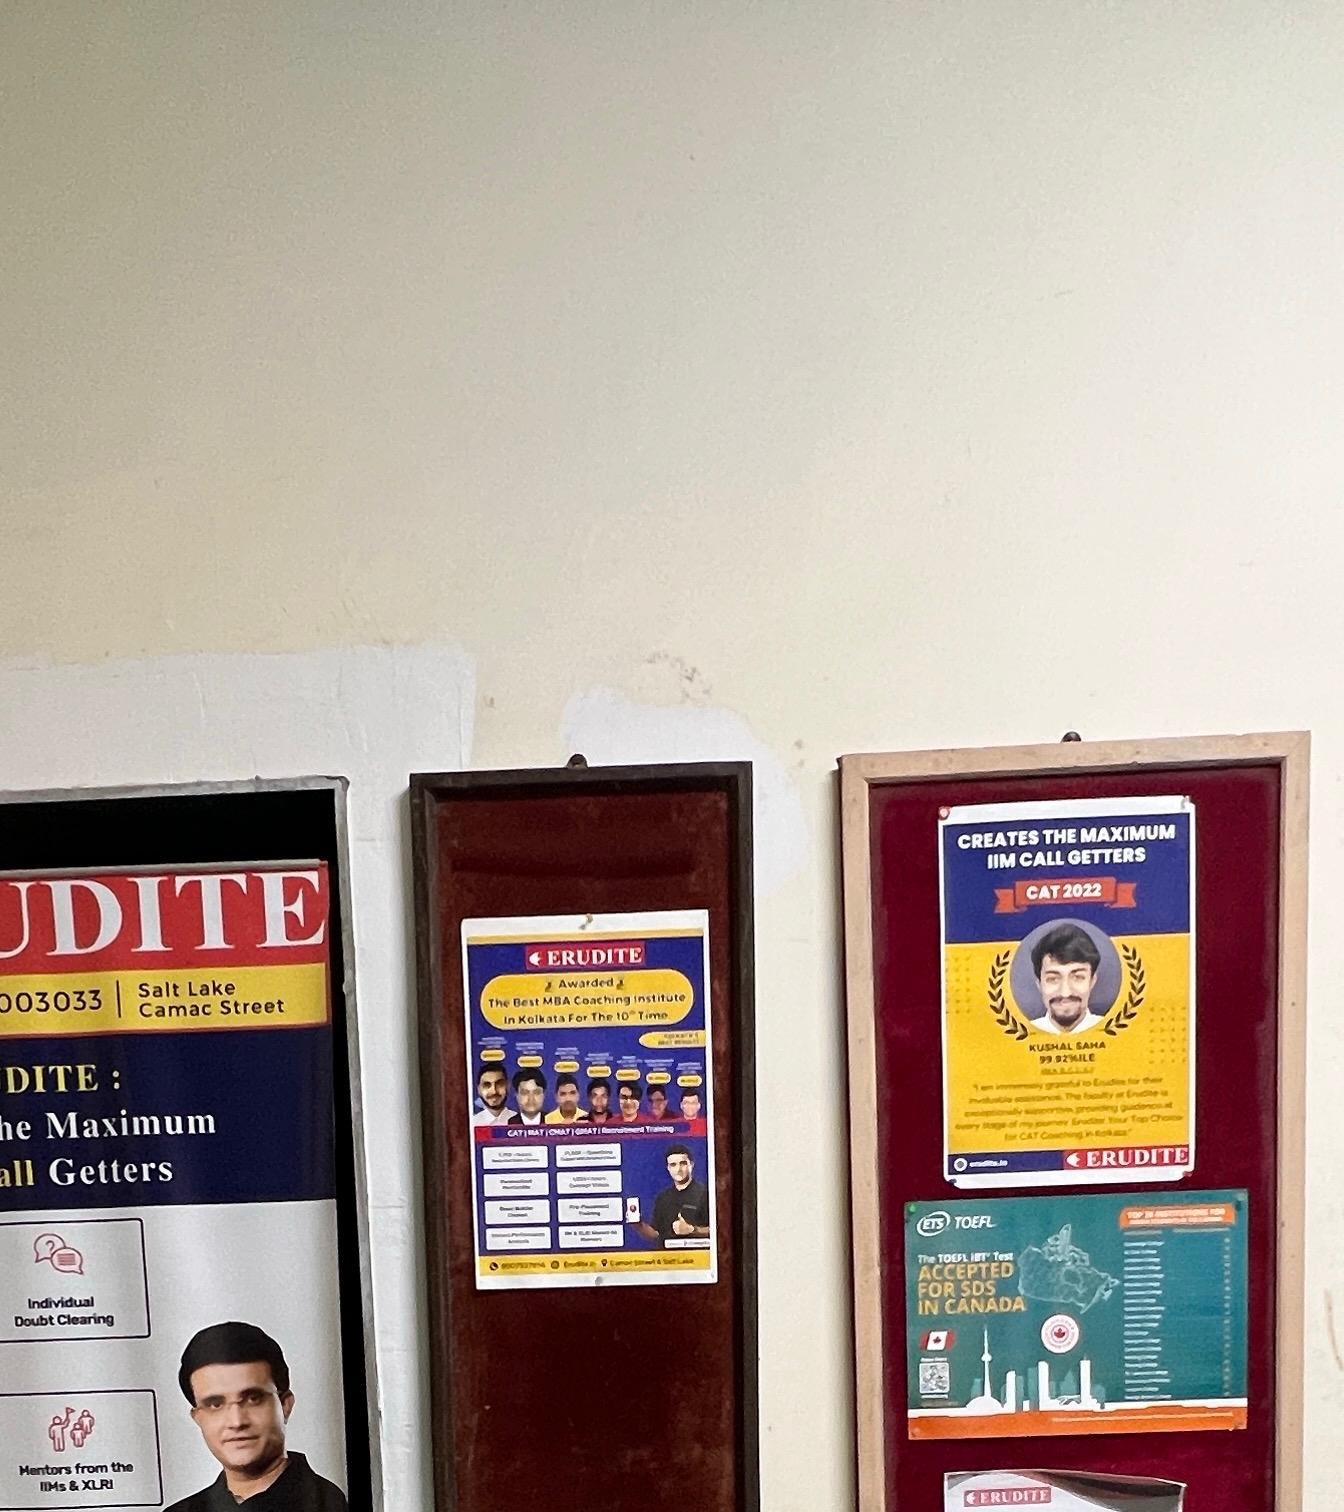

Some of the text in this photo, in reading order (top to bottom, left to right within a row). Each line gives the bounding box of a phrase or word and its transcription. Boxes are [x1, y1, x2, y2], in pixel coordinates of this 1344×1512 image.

[958, 824, 1176, 849] CREATES THE MAXIMUM
[987, 847, 1146, 869] IIM CALL GETTERS
[1026, 883, 1102, 900] CAT 2022
[547, 947, 643, 966] ERUDITE
[138, 978, 236, 999] Salt Lake
[558, 978, 614, 989] Awarded
[139, 997, 285, 1019] Camac Street
[488, 993, 686, 1008] The Best MBA Coaching Institute
[504, 1016, 516, 1025] In
[518, 1014, 566, 1025] Kolkata
[568, 1013, 588, 1023] For
[591, 1012, 613, 1023] The
[638, 1010, 669, 1021] Time
[1029, 1041, 1106, 1052] KUSHAL SAHA
[45, 1109, 217, 1139] Maximum
[1086, 1148, 1189, 1168] ERUDITE
[49, 1156, 173, 1187] Getters
[922, 1215, 997, 1230] ETS TOEFL
[918, 1250, 1014, 1264] The TOEFL Test
[918, 1261, 1015, 1281] ACCEPTED
[918, 1280, 996, 1298] FOR SDS
[28, 1296, 95, 1309] Individual
[918, 1295, 1027, 1315] IN CANADA
[14, 1313, 115, 1327] Doubt Clearing
[19, 1461, 135, 1476] Mentors from the
[40, 1479, 114, 1492] IIMs & XLRI
[979, 1489, 1050, 1504] ERUDITE
